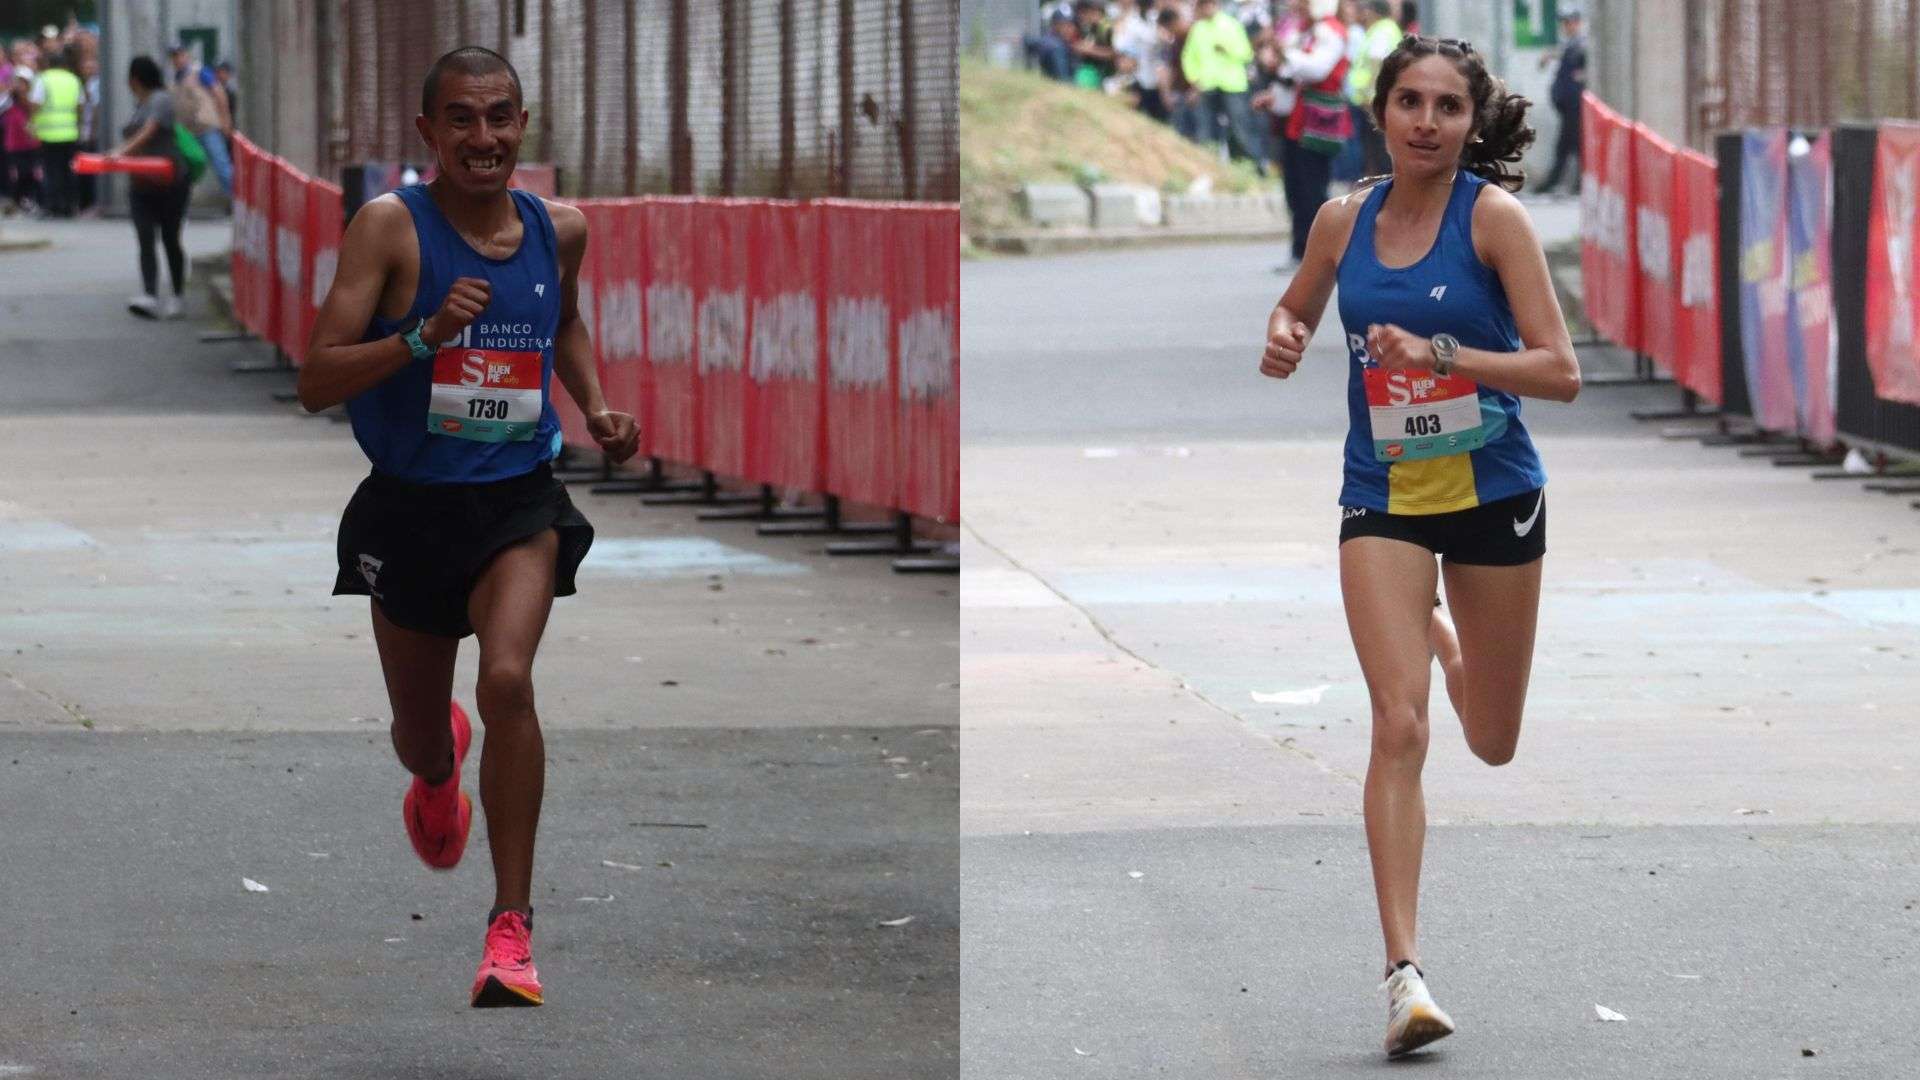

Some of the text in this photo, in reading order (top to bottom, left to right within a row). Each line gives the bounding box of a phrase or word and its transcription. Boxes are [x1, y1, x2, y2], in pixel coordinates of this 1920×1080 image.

[480, 323, 532, 335] BANCO
[488, 363, 511, 375] BUEN
[487, 373, 501, 383] PIE
[1411, 379, 1436, 391] BUEN
[467, 398, 509, 420] 1730
[1404, 413, 1442, 436] 403
